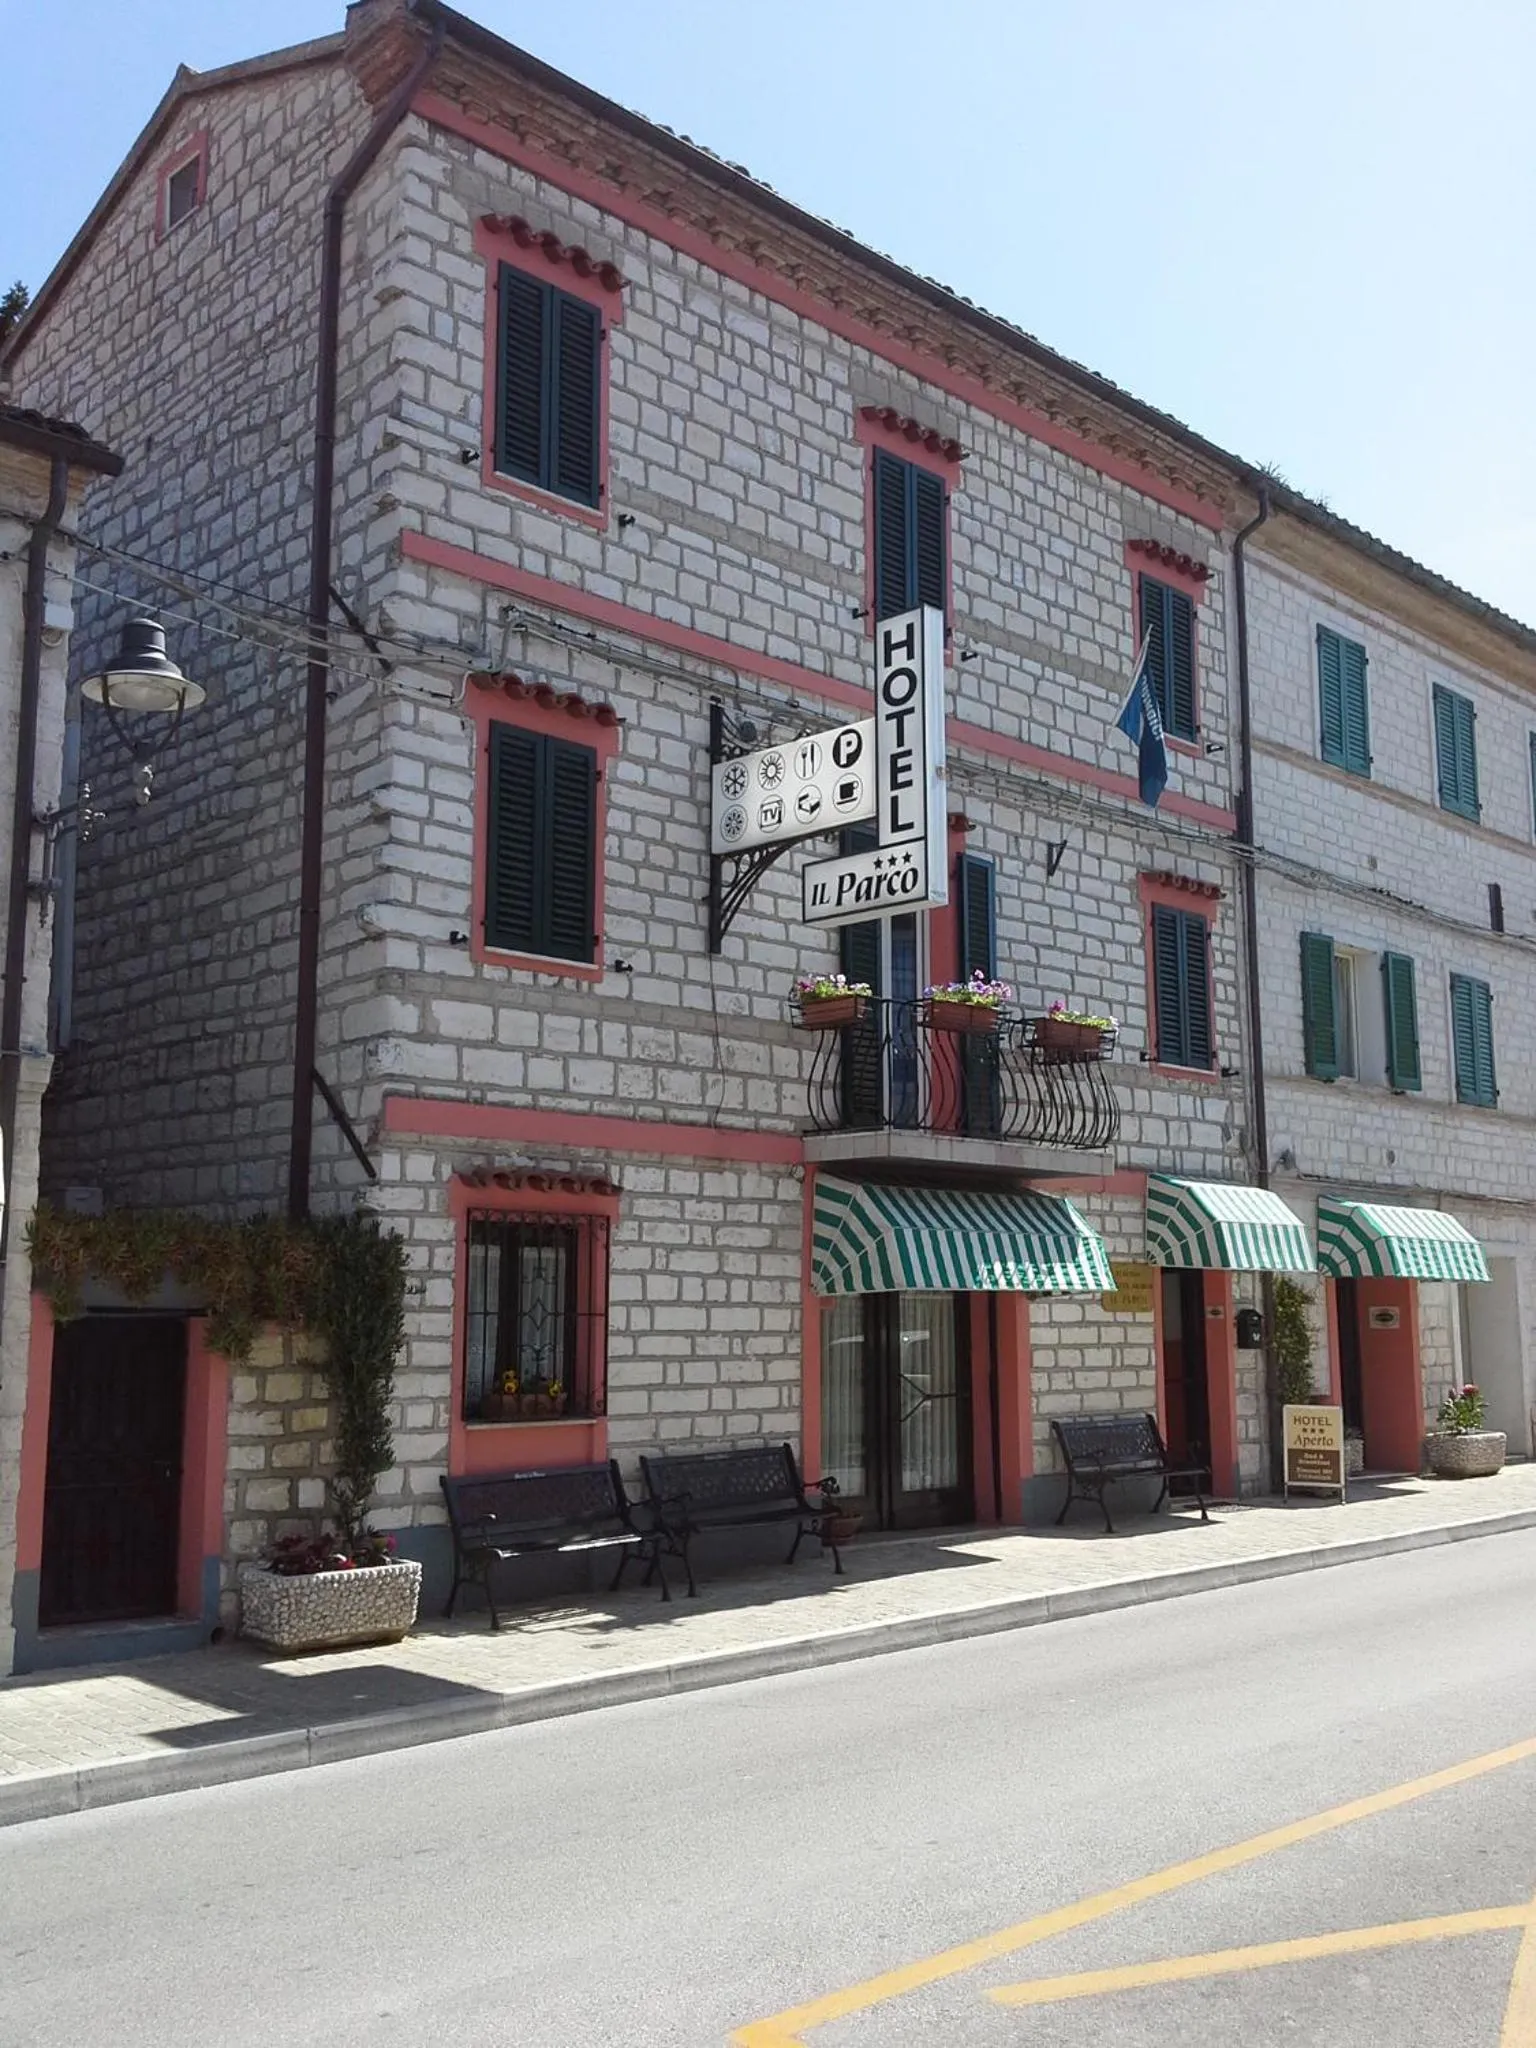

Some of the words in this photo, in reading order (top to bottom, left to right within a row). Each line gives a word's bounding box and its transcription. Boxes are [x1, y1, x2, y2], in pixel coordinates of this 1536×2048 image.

[882, 623, 917, 834] HOTEL
[839, 732, 858, 766] P
[763, 807, 779, 821] TV
[836, 867, 919, 907] Parco
[1293, 1416, 1332, 1426] HOTEL
[1294, 1435, 1334, 1447] Aperto
